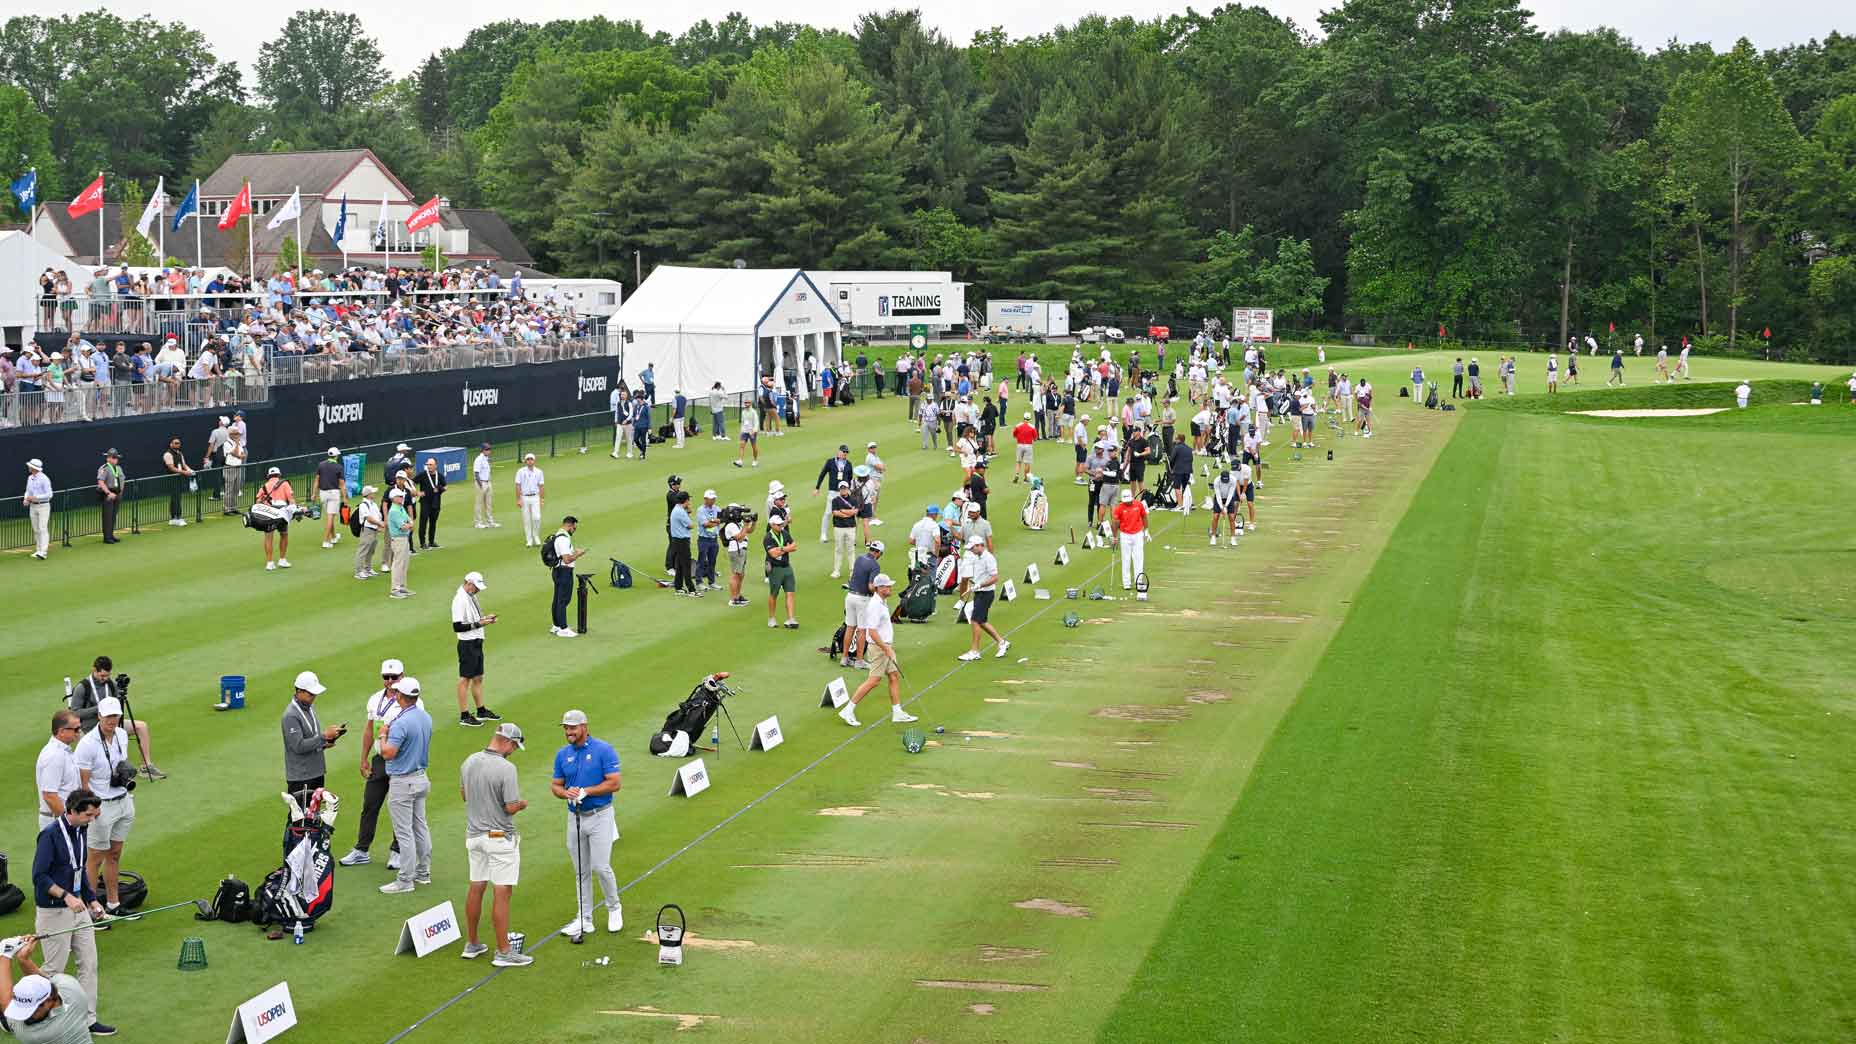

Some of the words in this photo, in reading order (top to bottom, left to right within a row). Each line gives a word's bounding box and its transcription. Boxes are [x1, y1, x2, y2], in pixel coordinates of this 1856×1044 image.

[892, 295, 941, 307] TRAINING
[583, 375, 607, 393] USOPEN
[468, 387, 498, 407] USOPEN
[326, 402, 363, 424] USOPEN
[424, 917, 451, 938] USOPEN
[257, 1001, 286, 1027] USOPEN
